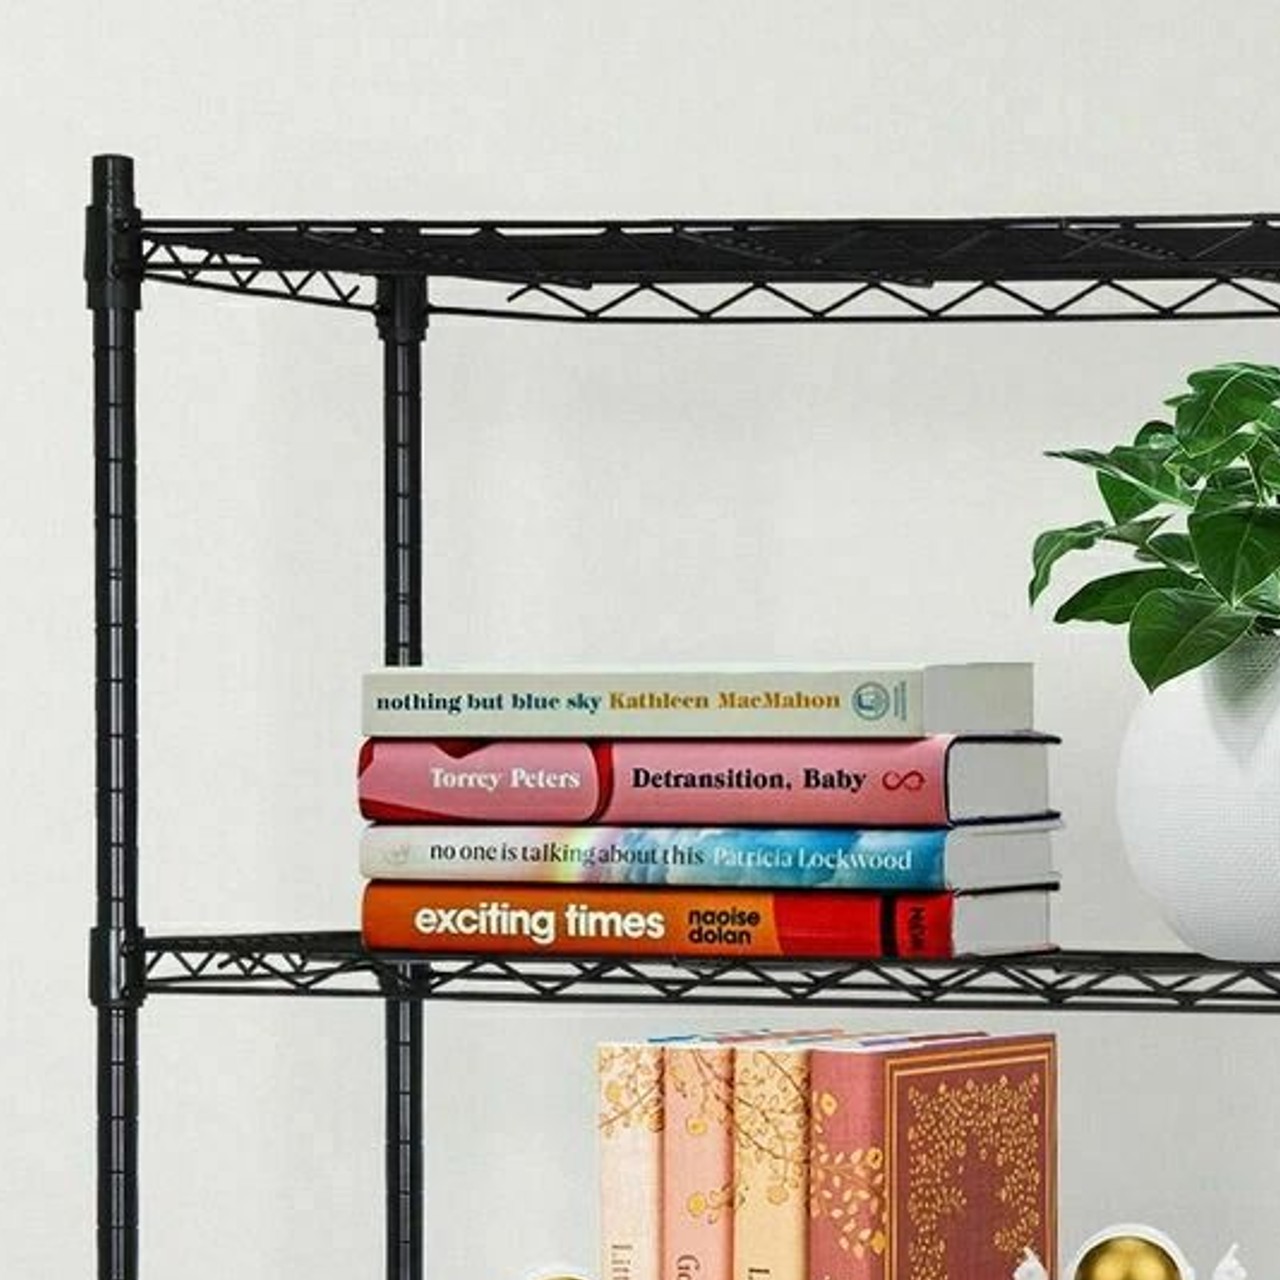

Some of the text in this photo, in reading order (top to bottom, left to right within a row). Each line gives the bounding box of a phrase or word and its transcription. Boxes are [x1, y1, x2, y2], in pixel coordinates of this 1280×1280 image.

[376, 690, 841, 715] nothing but blue sky Kathleen MacMahon
[431, 767, 581, 792] Torrey Peters
[632, 767, 867, 793] Detransition, Baby
[430, 842, 912, 870] no one is talking about this Patricia Lockwood
[414, 902, 666, 945] exciting times
[688, 906, 761, 927] naoise
[688, 926, 752, 945] dolan
